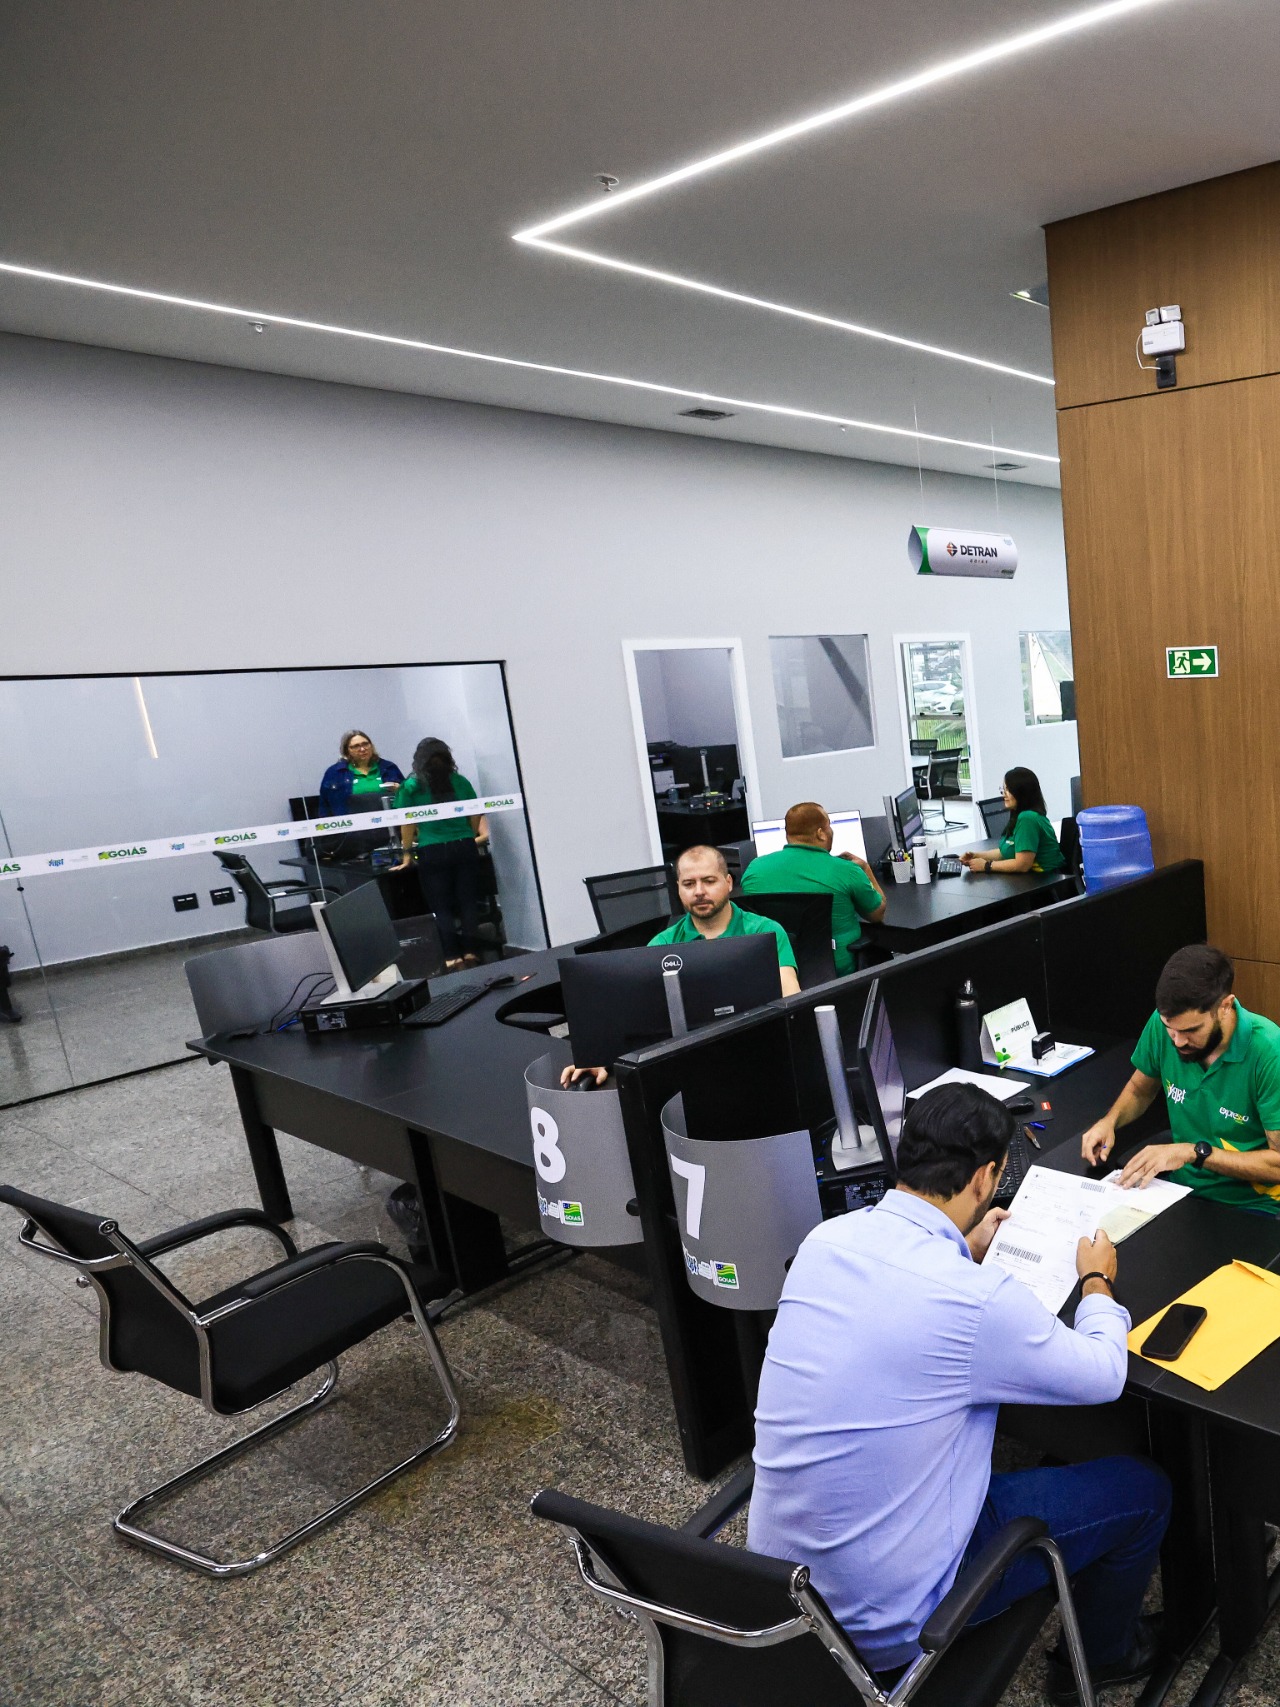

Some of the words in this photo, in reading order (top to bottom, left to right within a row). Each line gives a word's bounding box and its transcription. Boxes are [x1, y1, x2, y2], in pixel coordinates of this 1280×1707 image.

[960, 545, 998, 557] DETRAN
[223, 832, 257, 843] GOIÁS
[107, 846, 148, 858] GOIÁS
[531, 1106, 566, 1183] 8
[670, 1153, 706, 1239] 7
